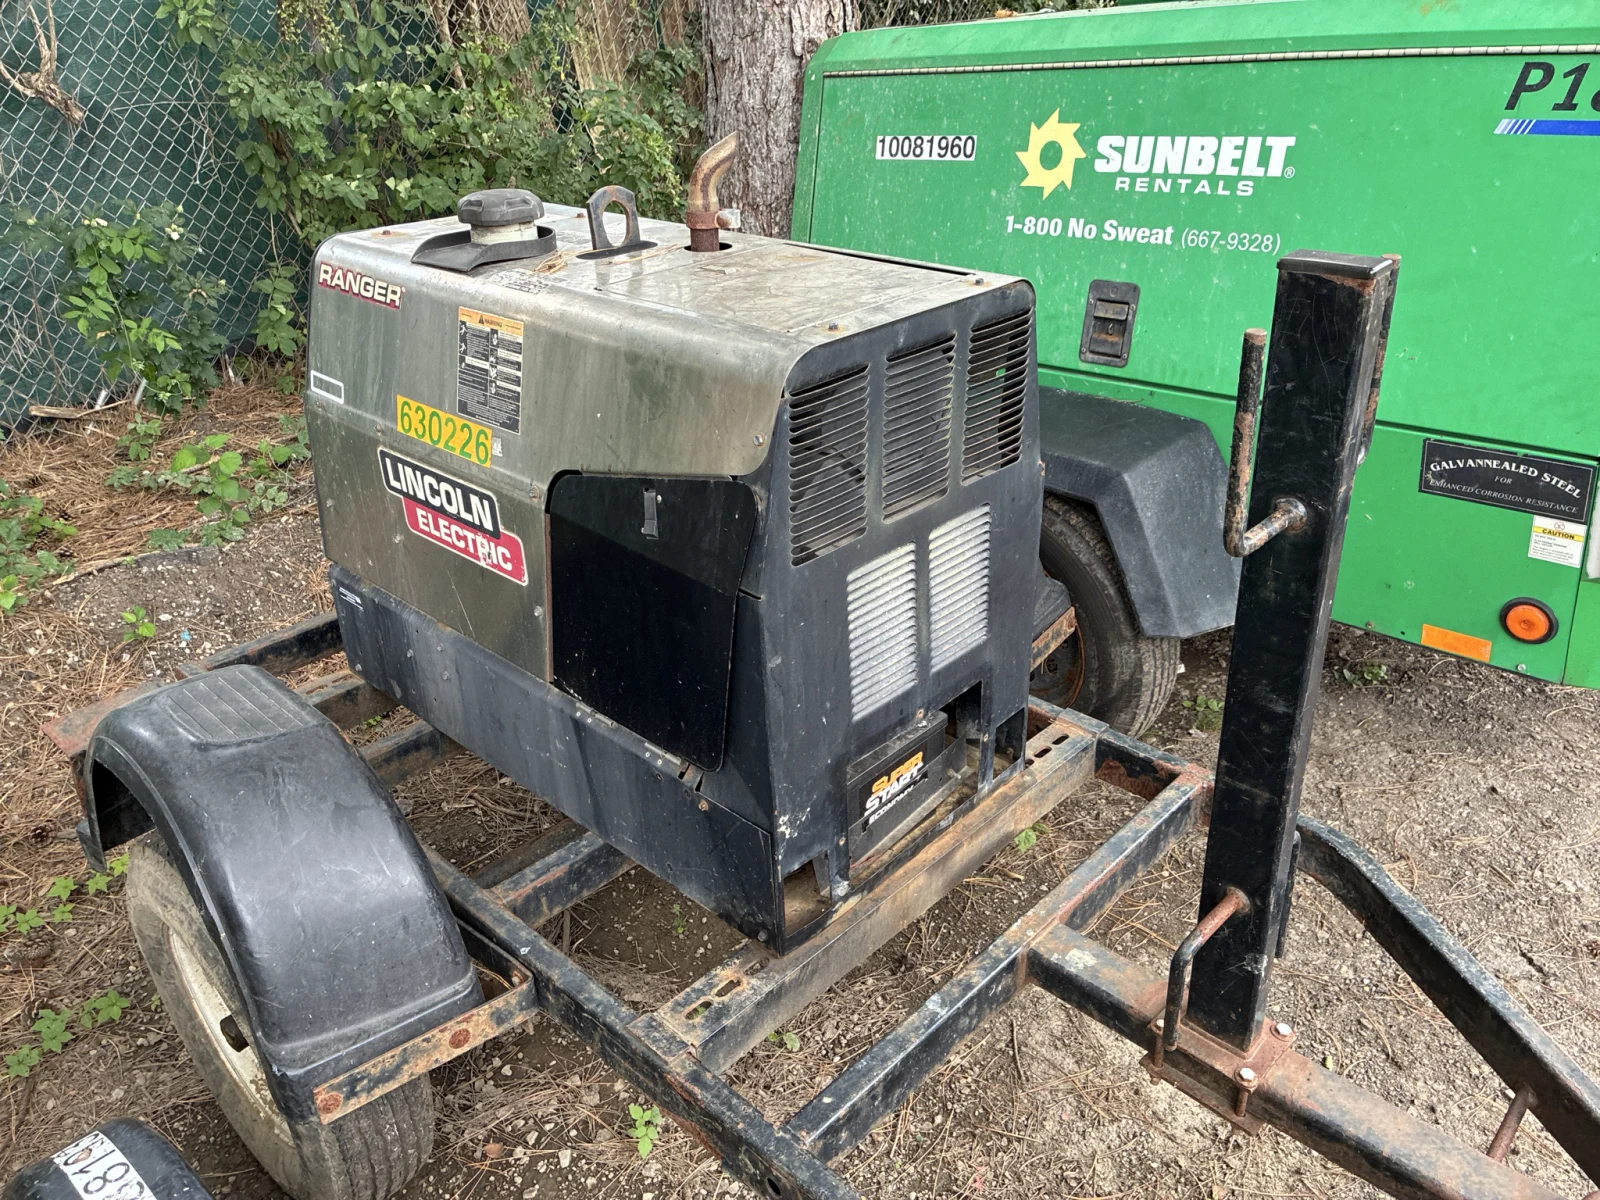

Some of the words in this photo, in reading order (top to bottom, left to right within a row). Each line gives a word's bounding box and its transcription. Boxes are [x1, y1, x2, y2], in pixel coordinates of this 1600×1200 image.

[1504, 61, 1600, 112] P1
[879, 135, 976, 159] 10081960
[1114, 177, 1255, 196] RENTALS
[1005, 215, 1063, 236] 1-800
[1067, 217, 1098, 239] No
[1102, 219, 1175, 245] Sweat
[1181, 227, 1282, 256] (667-9328)
[400, 400, 490, 465] 630226
[385, 457, 494, 532] LINCOLN
[1430, 458, 1538, 477] GALVANNEALED
[1541, 472, 1582, 499] STEEL
[1430, 479, 1474, 493] ENHANCED
[1475, 488, 1525, 503] CORROSION
[1525, 497, 1578, 514] RESISTANCE
[1494, 475, 1513, 485] FOR
[416, 507, 513, 571] ELECTRIC
[1542, 528, 1575, 540] CAUTION
[864, 761, 924, 817] START
[871, 751, 924, 796] SUPER
